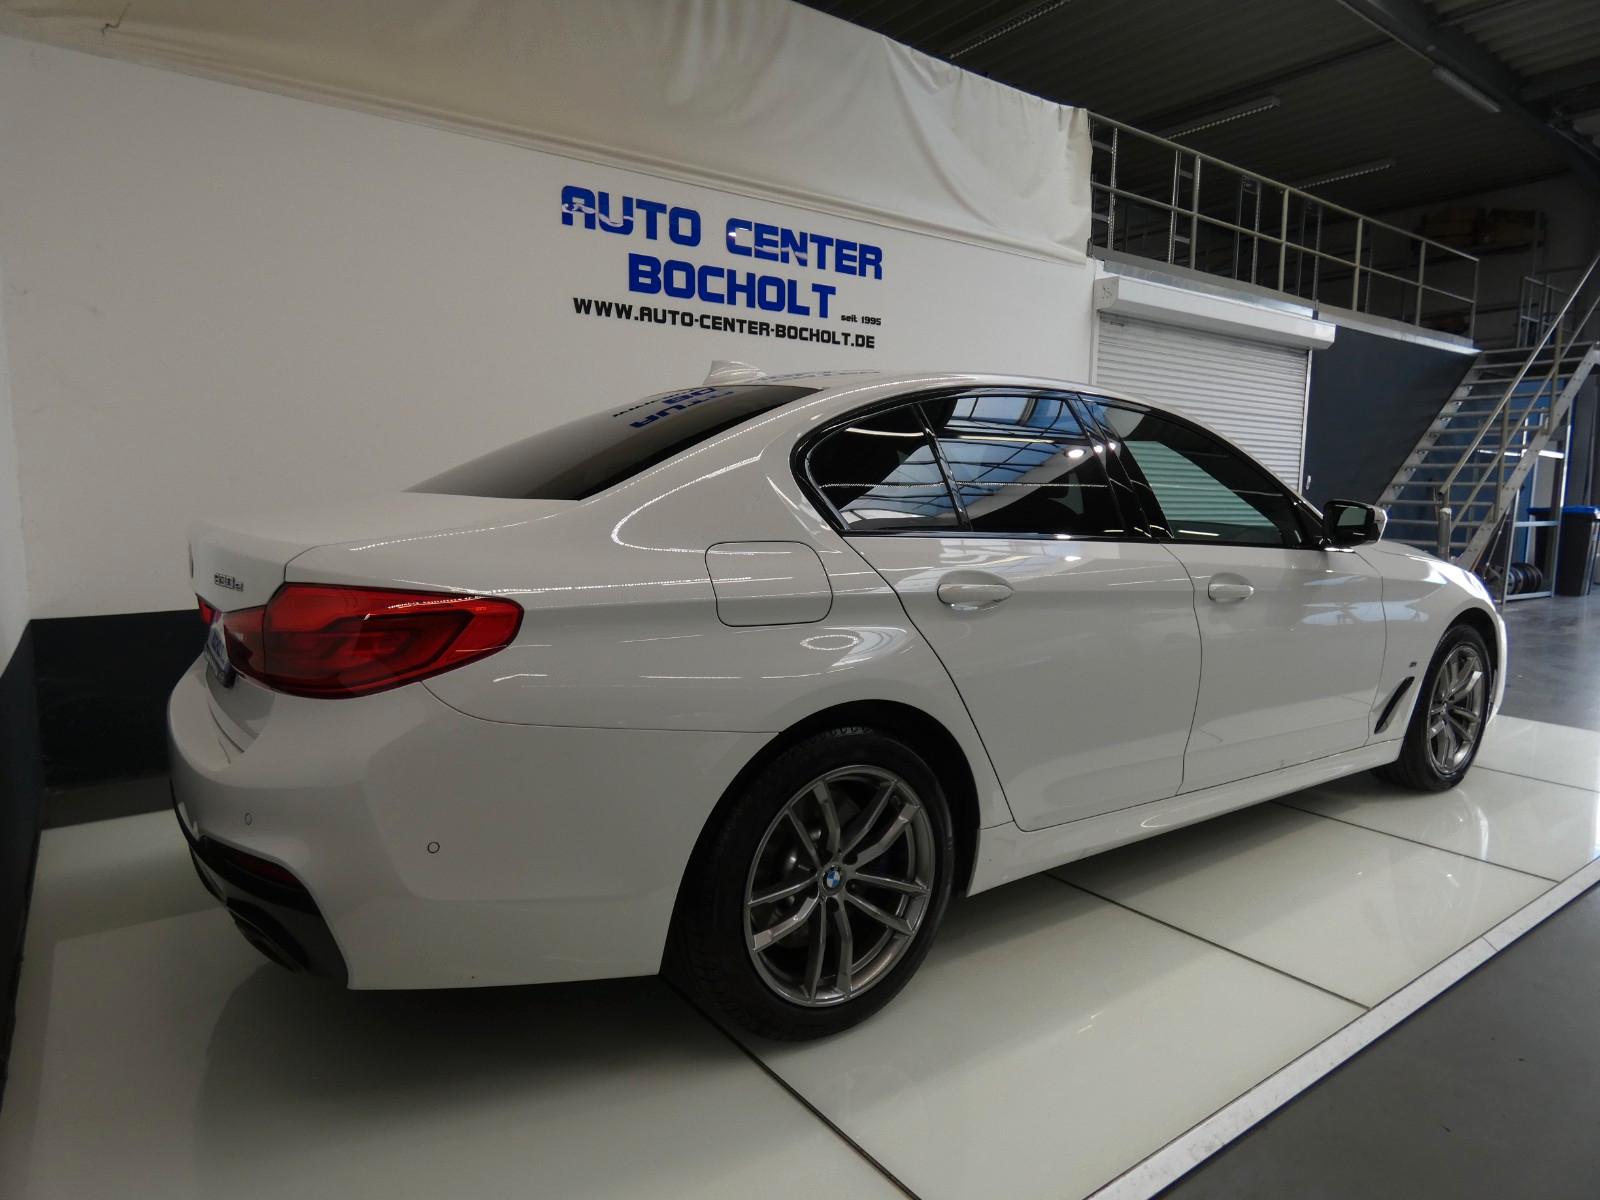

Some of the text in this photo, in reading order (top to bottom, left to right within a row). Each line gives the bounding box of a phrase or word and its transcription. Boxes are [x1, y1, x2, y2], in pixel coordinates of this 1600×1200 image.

[562, 185, 883, 280] AUTO CENTER
[629, 253, 836, 318] BOCHOLT
[573, 297, 875, 349] WWW.AUTO-CENTER-BOCHOLT.DE
[841, 314, 882, 326] seit 1995
